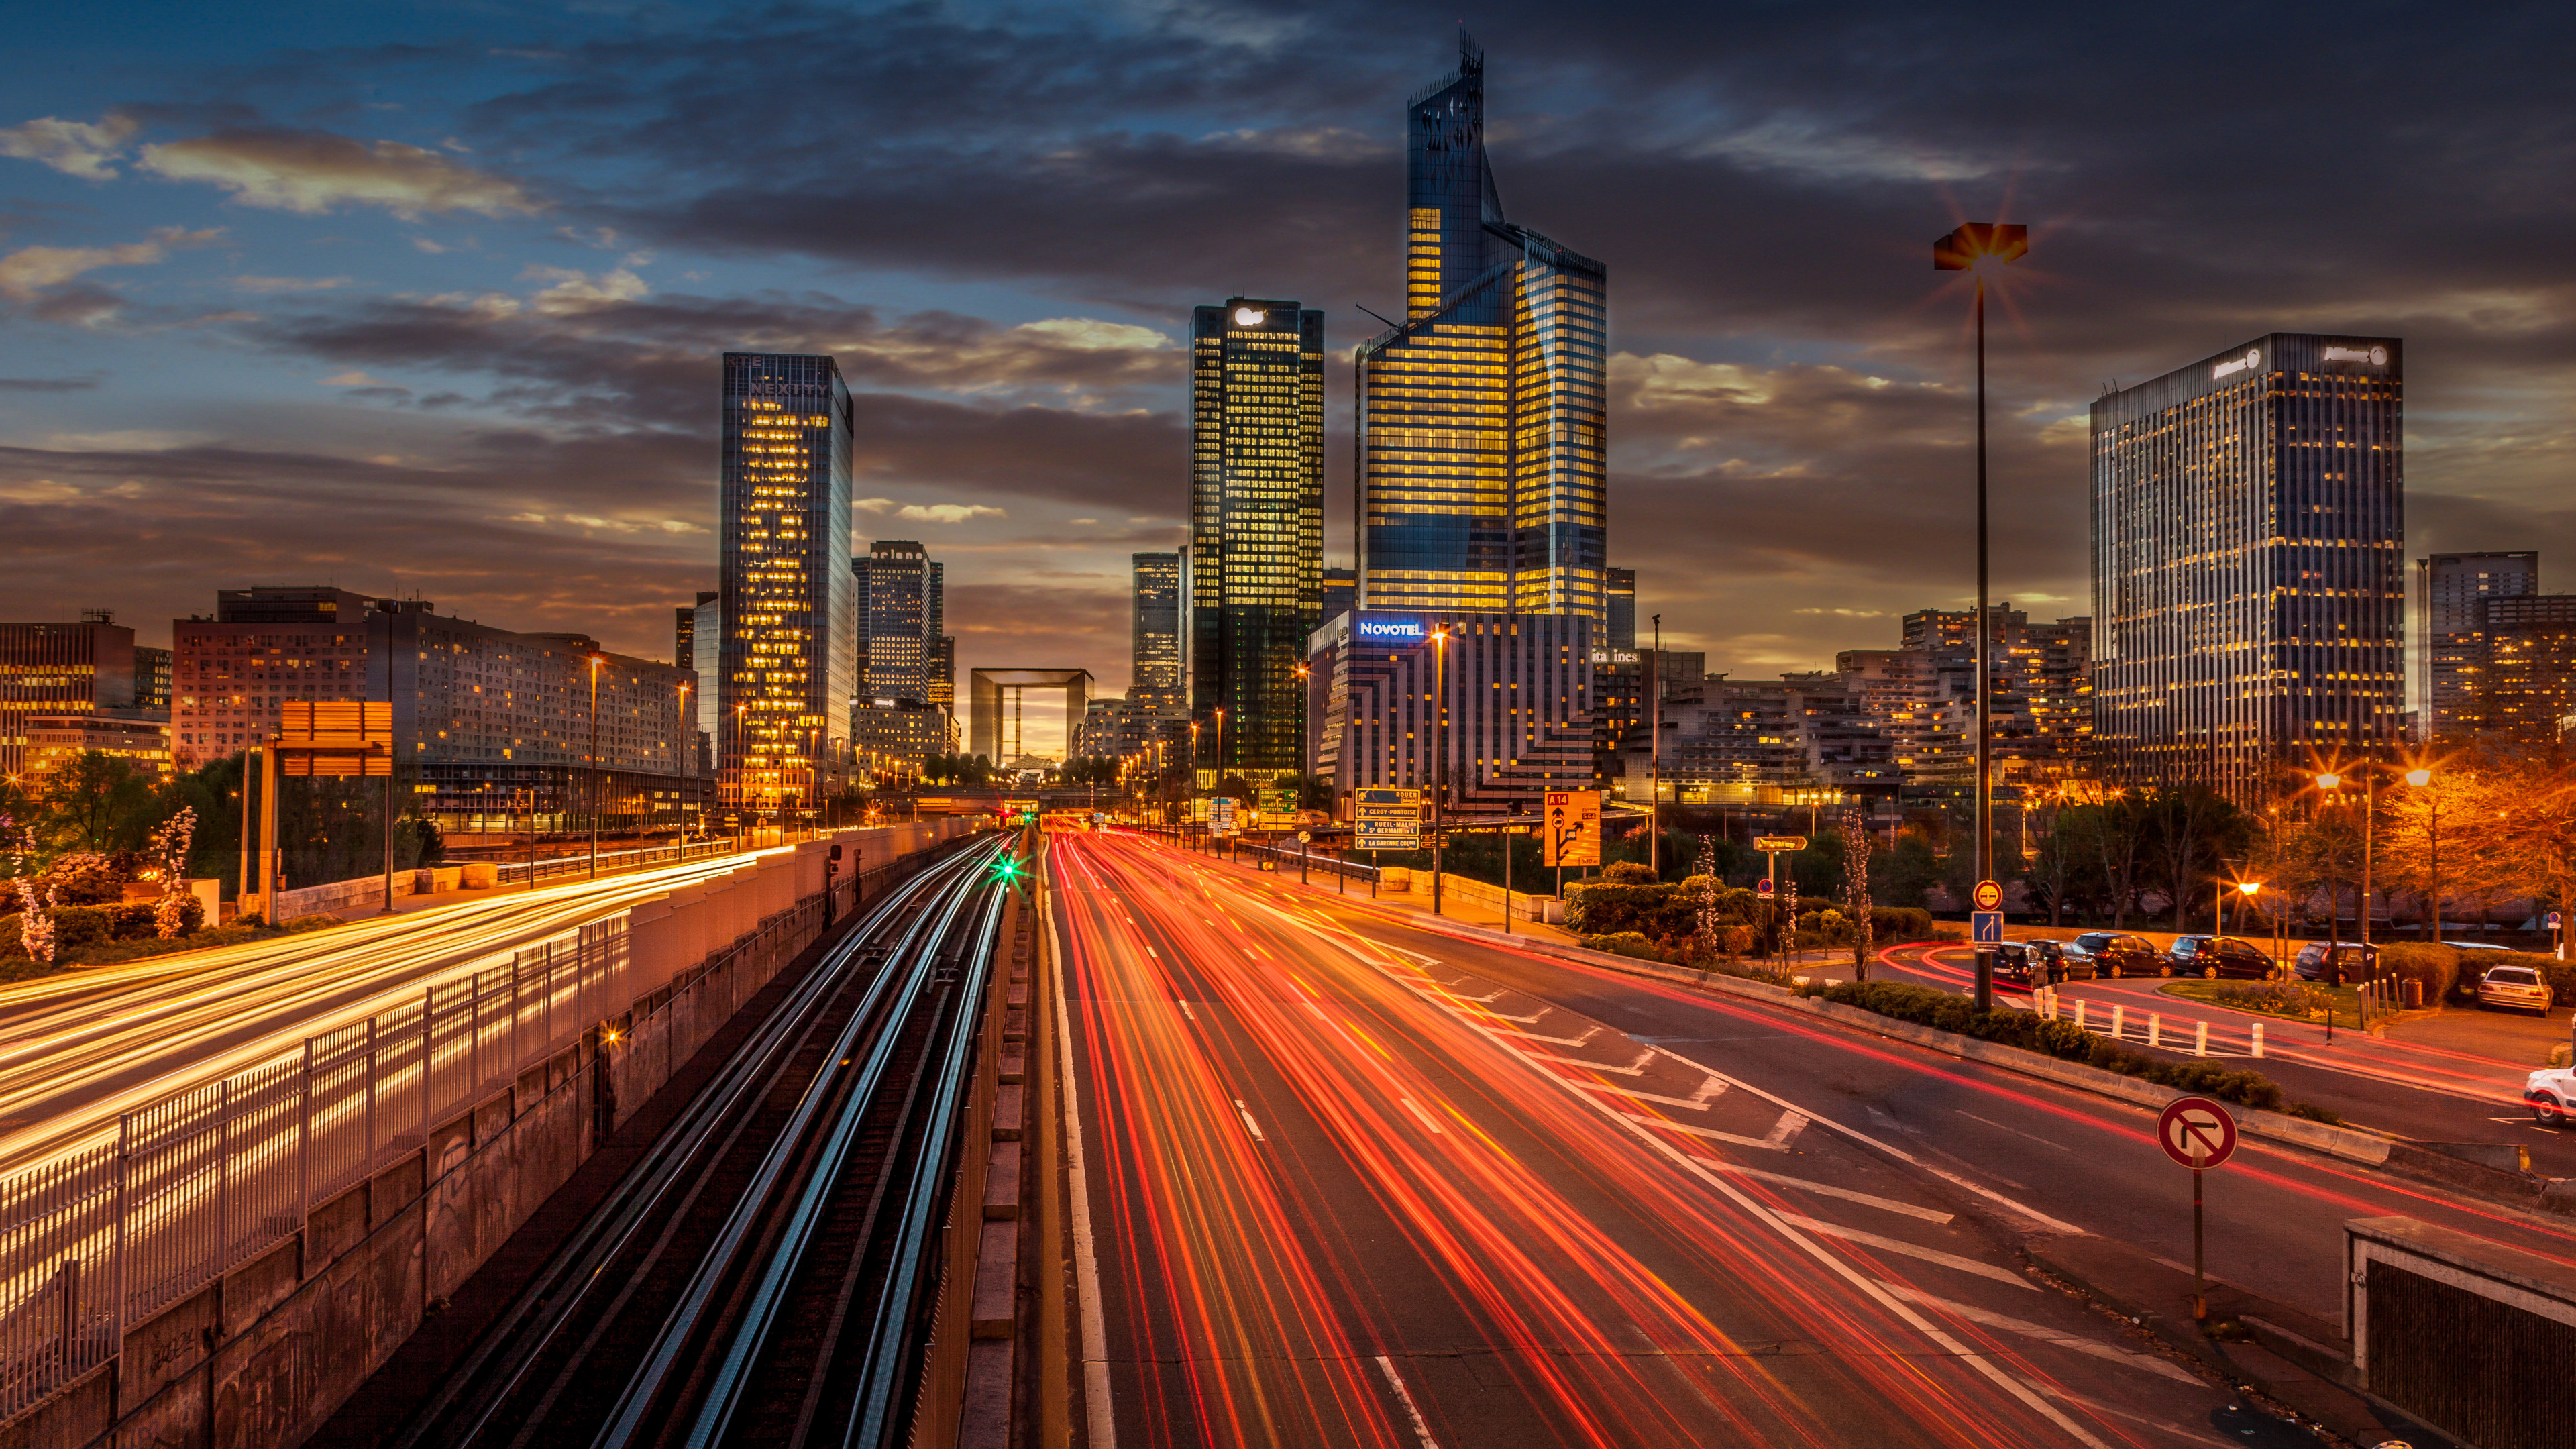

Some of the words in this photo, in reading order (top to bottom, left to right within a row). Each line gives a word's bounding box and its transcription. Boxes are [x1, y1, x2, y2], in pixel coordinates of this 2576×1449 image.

[1360, 623, 1424, 636] NOVOTEL
[1549, 795, 1555, 804] A
[1557, 795, 1567, 804] 14
